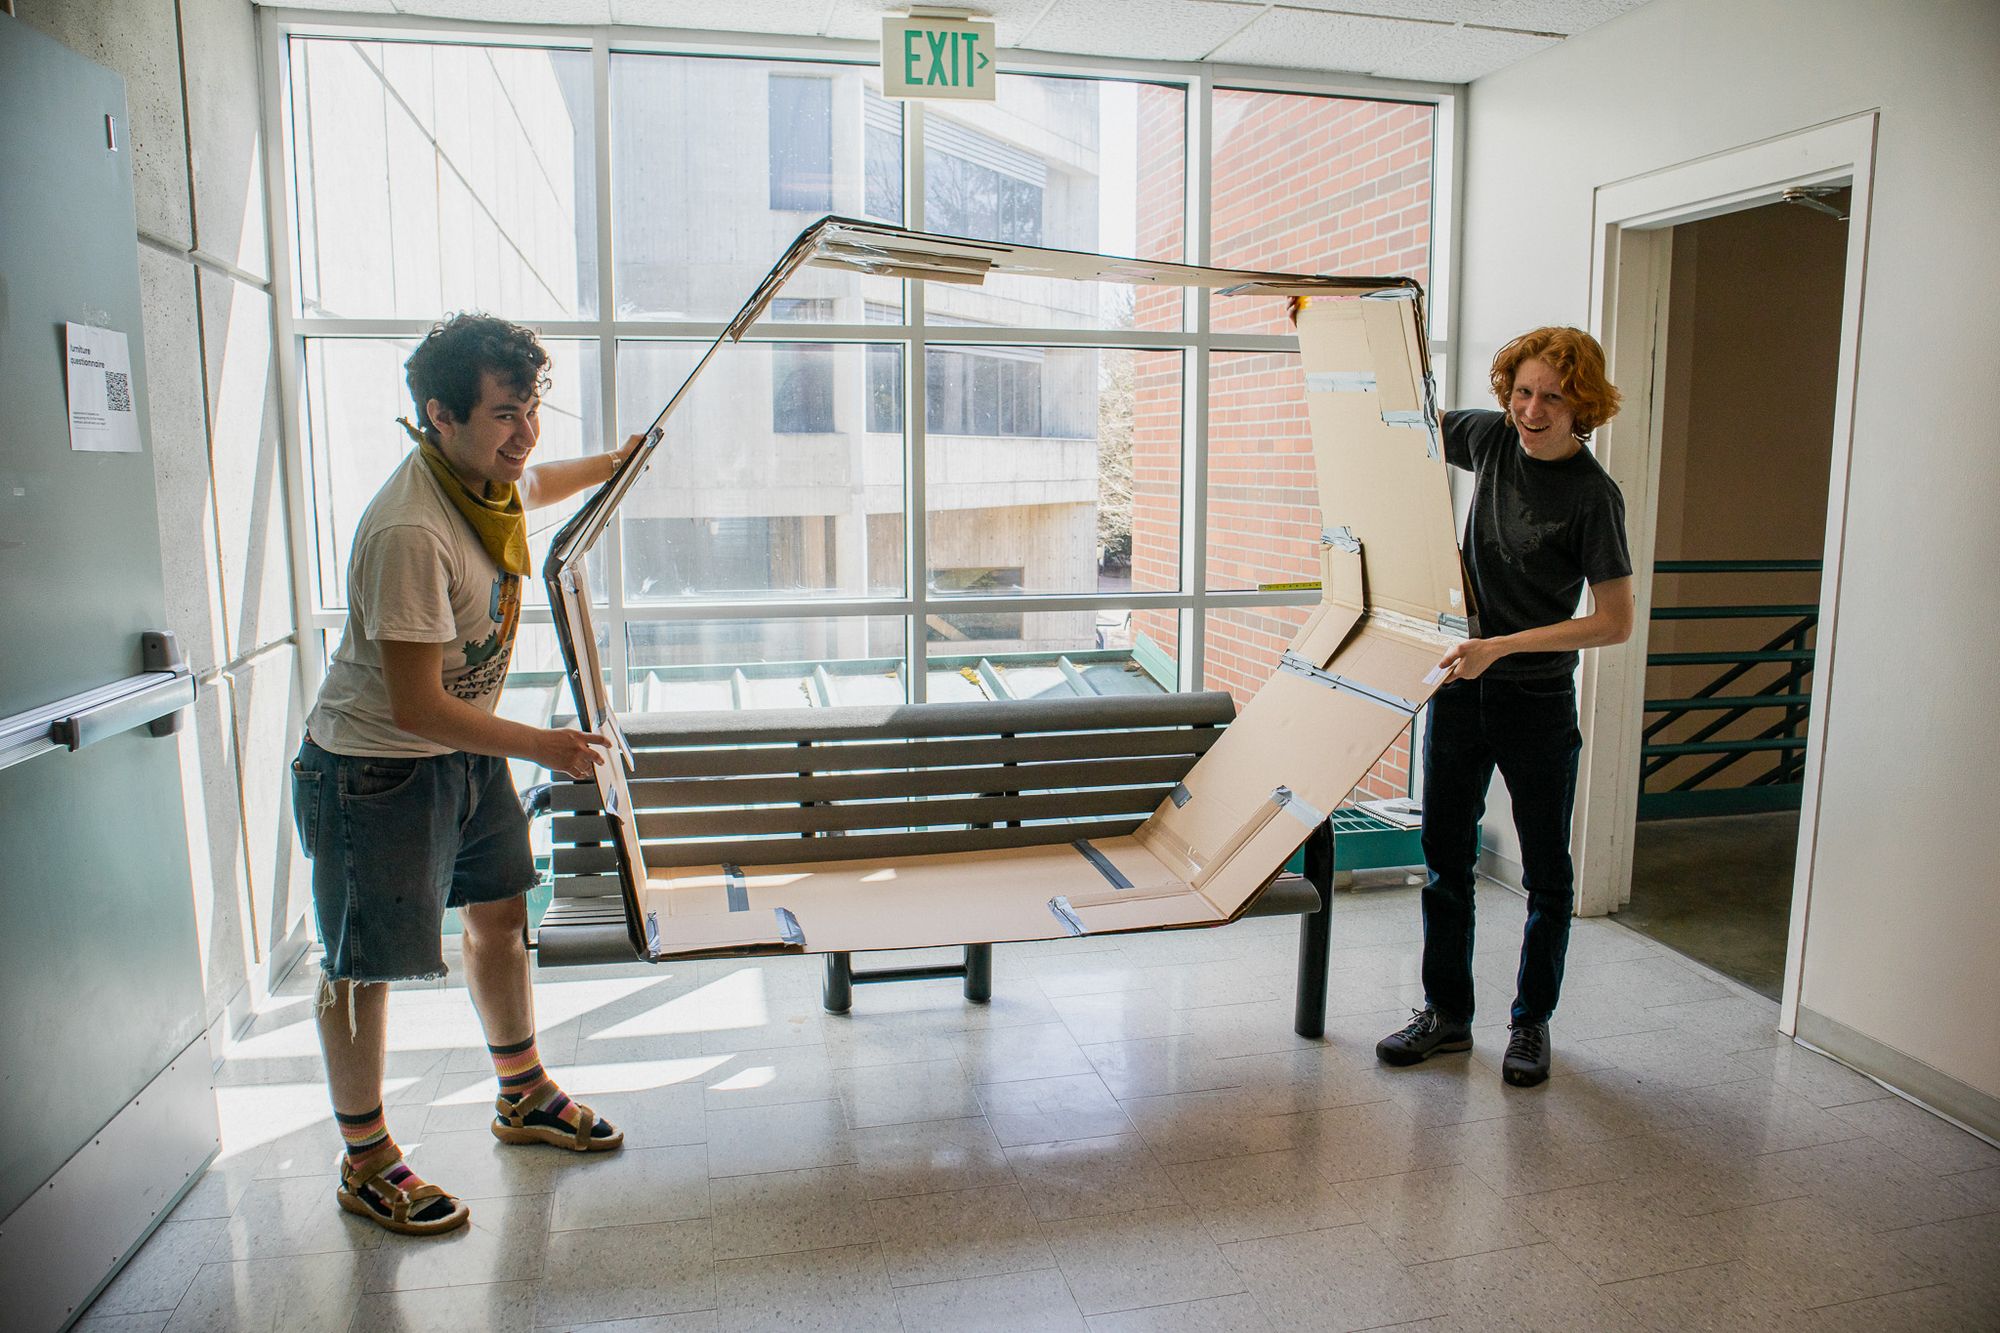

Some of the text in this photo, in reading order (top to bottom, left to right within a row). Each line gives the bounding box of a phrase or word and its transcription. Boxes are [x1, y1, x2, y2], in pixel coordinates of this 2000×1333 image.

[904, 30, 979, 87] EXIT
[70, 345, 91, 355] furniture
[70, 357, 105, 369] questionnaire
